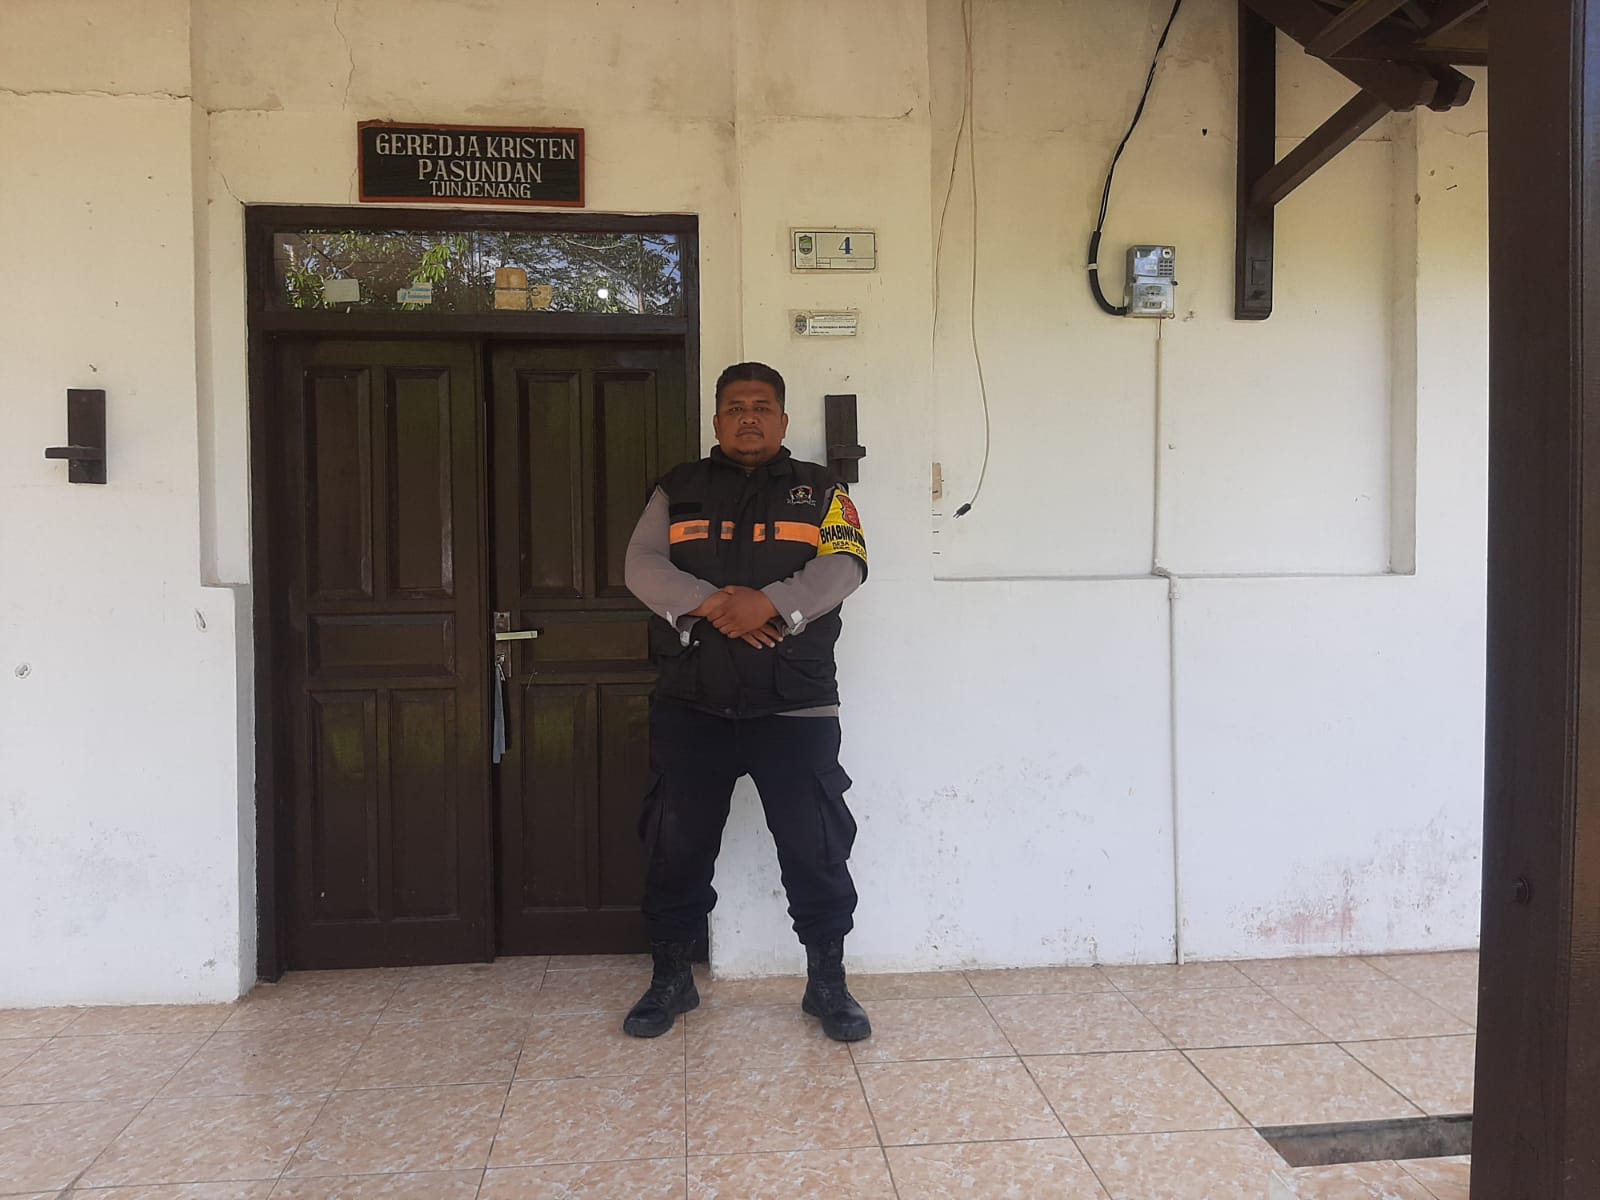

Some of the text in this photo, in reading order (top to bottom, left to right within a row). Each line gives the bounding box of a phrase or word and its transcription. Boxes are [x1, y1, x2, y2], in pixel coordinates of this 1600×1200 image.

[375, 133, 575, 159] GEREDJA KRISTEN
[418, 158, 542, 183] PASUNDAN
[838, 236, 853, 255] 4
